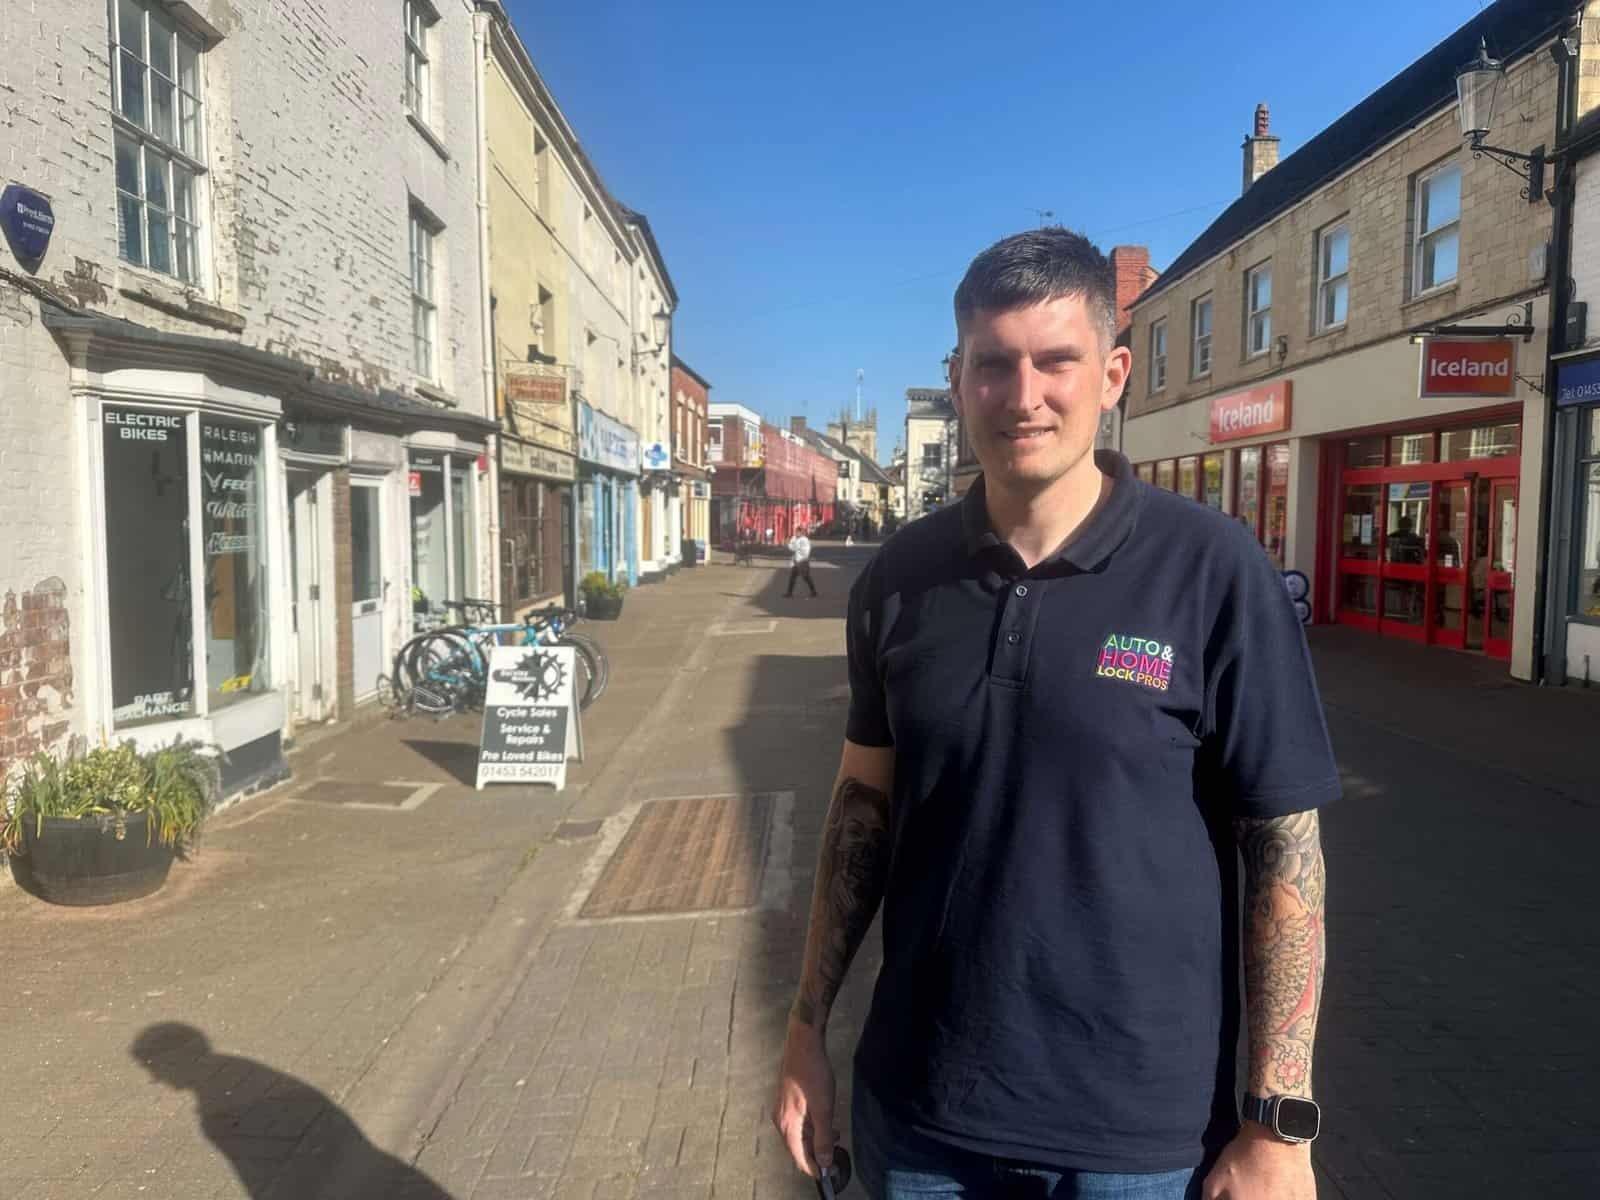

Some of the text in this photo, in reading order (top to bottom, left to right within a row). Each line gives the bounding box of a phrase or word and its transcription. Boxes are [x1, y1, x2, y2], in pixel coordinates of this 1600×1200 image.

[1430, 358, 1509, 377] Iceland
[104, 412, 182, 428] ELECTRIC
[1218, 393, 1275, 433] Iceland
[120, 427, 168, 441] BIKES
[204, 425, 256, 444] RALEIGH
[213, 450, 258, 465] MARIN
[1104, 633, 1174, 661] AUTO &
[1100, 647, 1172, 679] HOME
[1097, 665, 1168, 690] LOCK PROS
[496, 707, 557, 719] Cycle Sales
[500, 723, 551, 734] Service &
[506, 734, 544, 745] Repairs
[502, 751, 534, 761] Loved
[537, 751, 562, 761] Bikes
[481, 766, 560, 777] 01453 542017
